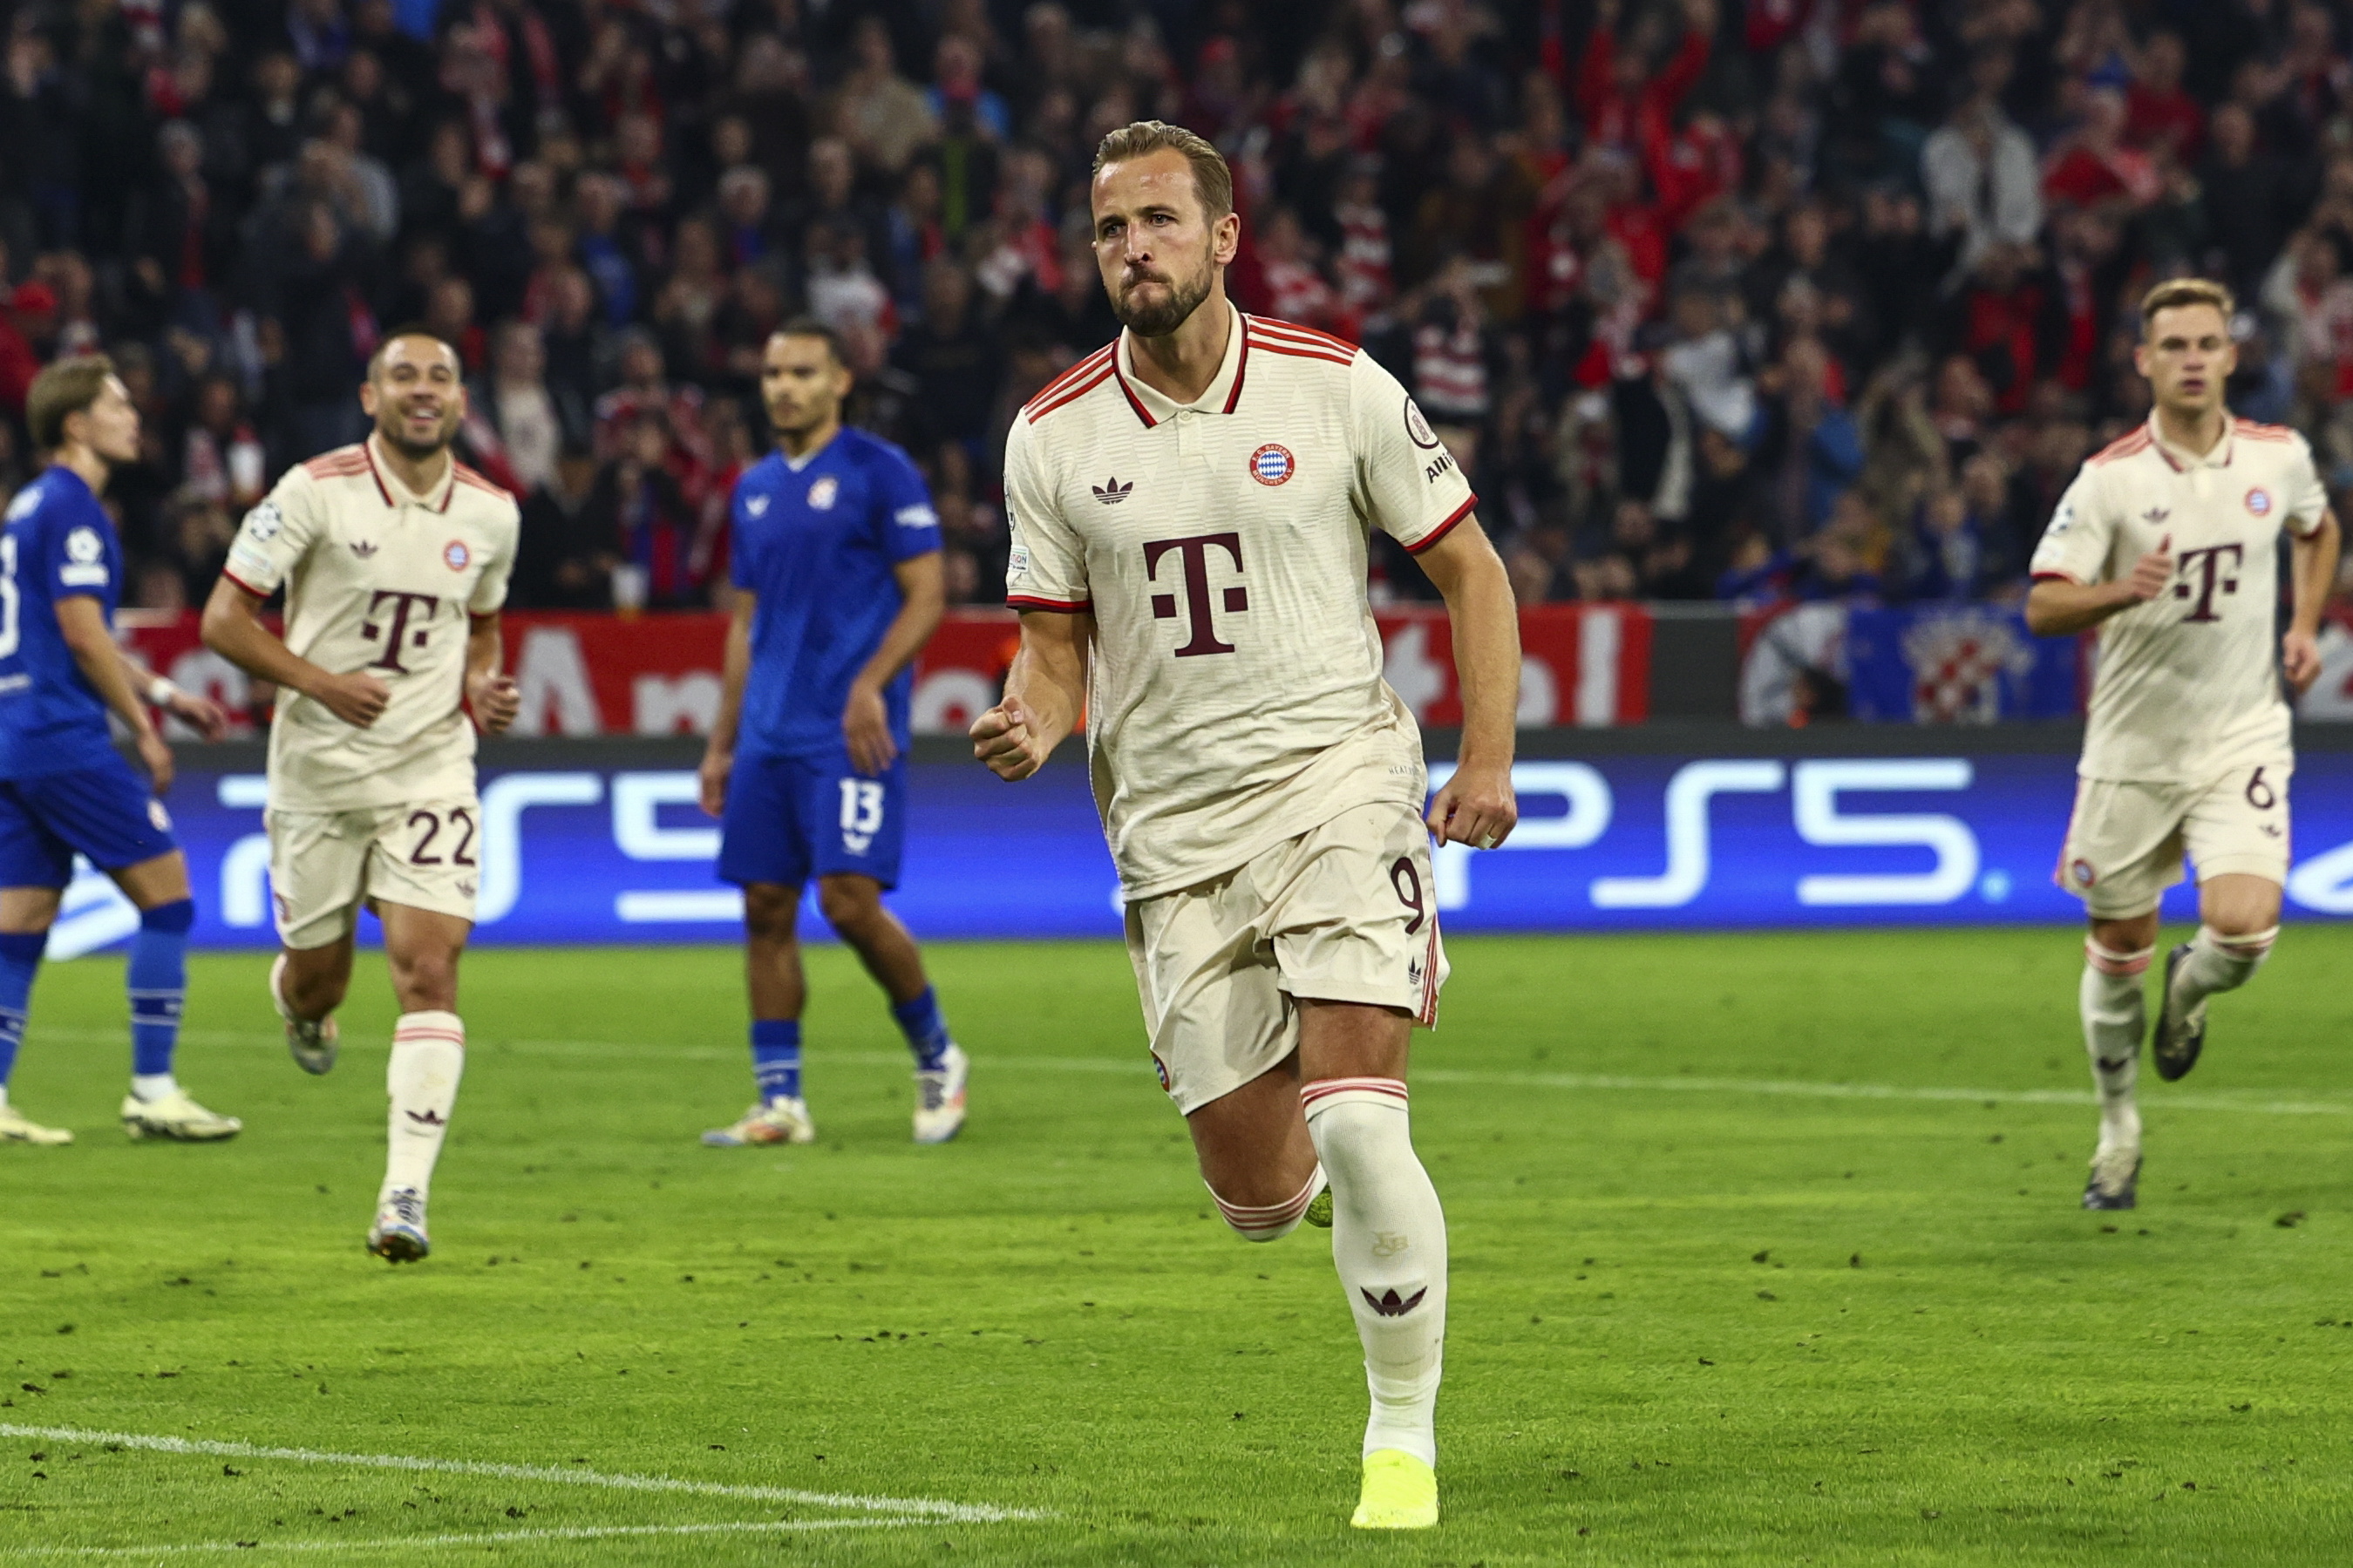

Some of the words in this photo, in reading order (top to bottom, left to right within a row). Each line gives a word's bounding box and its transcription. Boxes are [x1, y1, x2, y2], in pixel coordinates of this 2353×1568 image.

[1143, 532, 1248, 658] T
[2173, 543, 2243, 623] T
[361, 589, 439, 675] T
[839, 777, 885, 833] 13
[2246, 766, 2276, 810] 6
[408, 807, 475, 865] 22
[1426, 758, 1980, 910] PS5
[1391, 857, 1424, 935] 9
